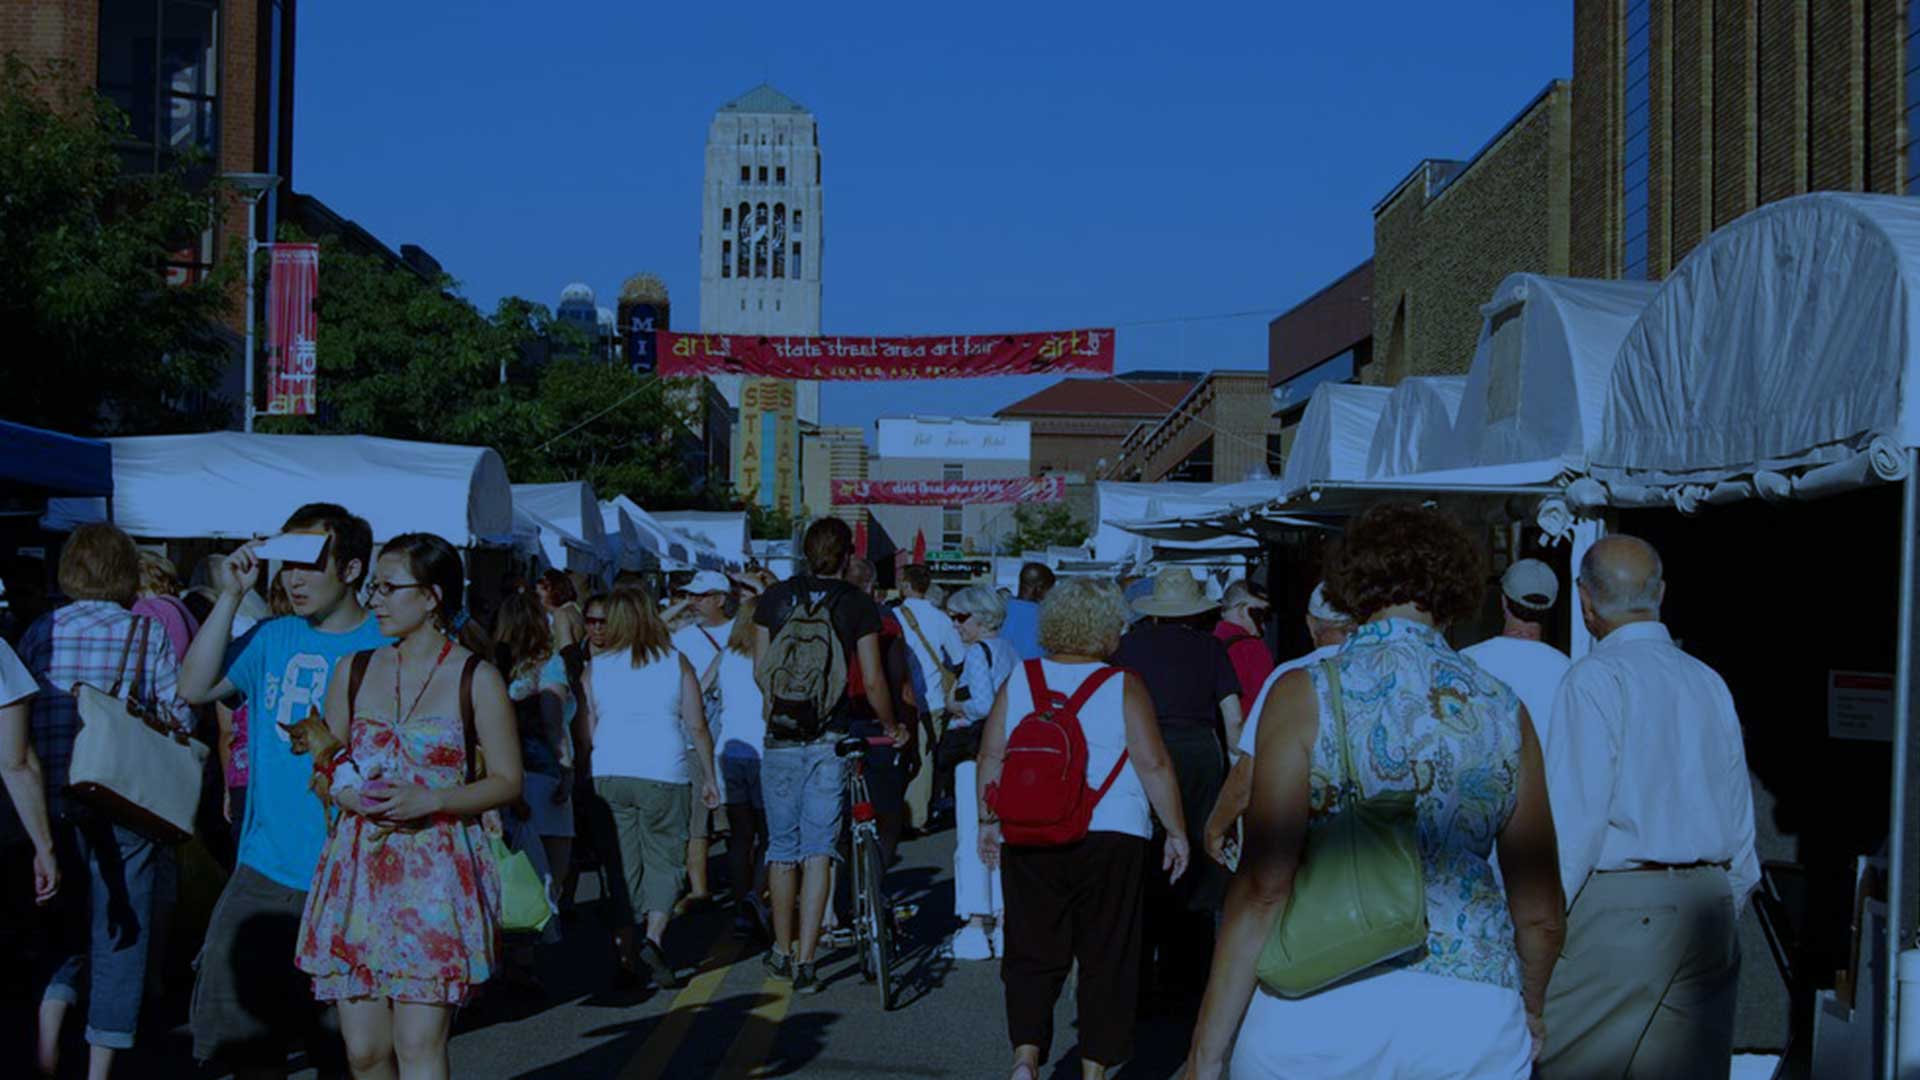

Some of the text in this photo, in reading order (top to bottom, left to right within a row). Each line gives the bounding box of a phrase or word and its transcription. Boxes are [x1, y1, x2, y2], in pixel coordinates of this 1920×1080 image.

[775, 336, 996, 358] state street area art fair
[267, 388, 316, 415] art
